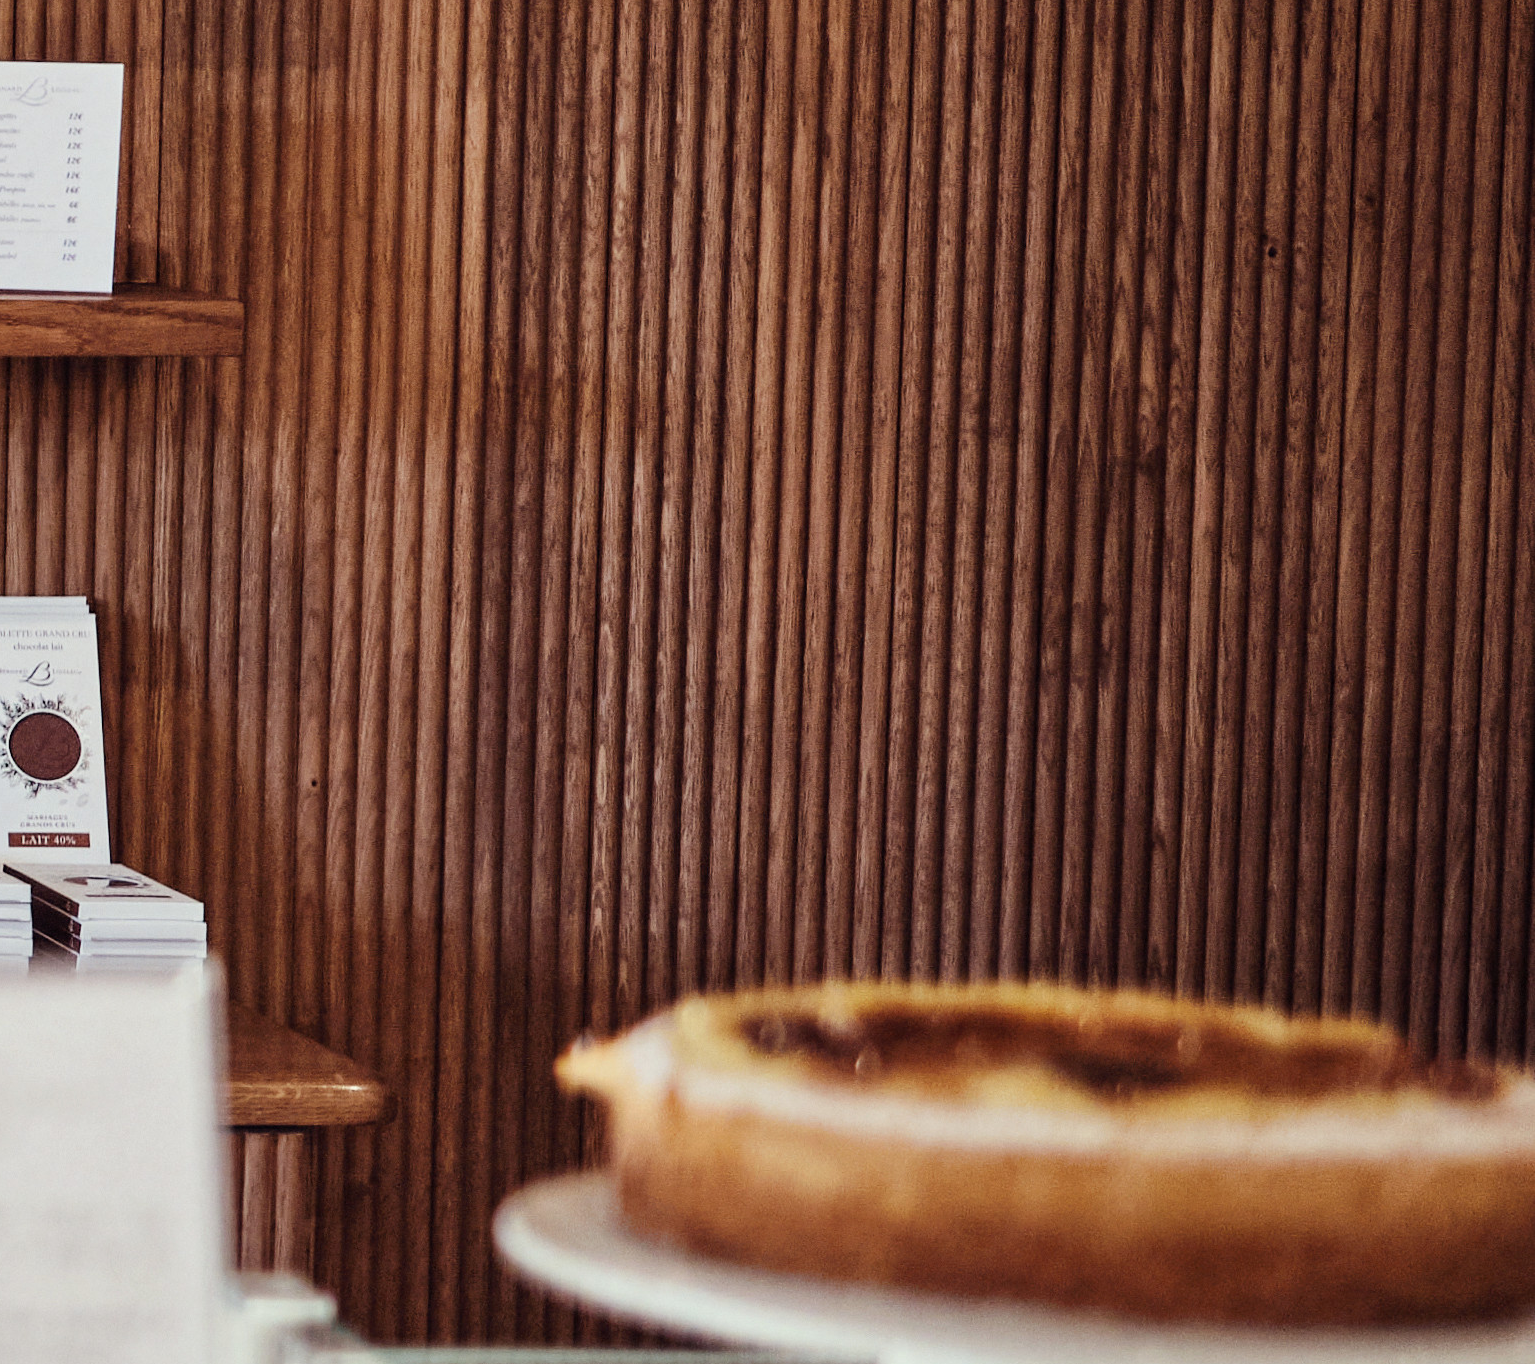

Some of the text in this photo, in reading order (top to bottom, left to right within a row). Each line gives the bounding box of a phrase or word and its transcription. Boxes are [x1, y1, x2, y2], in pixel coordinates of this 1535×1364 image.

[13, 642, 63, 650] chocolat lait
[21, 835, 76, 845] LAIT 40%
